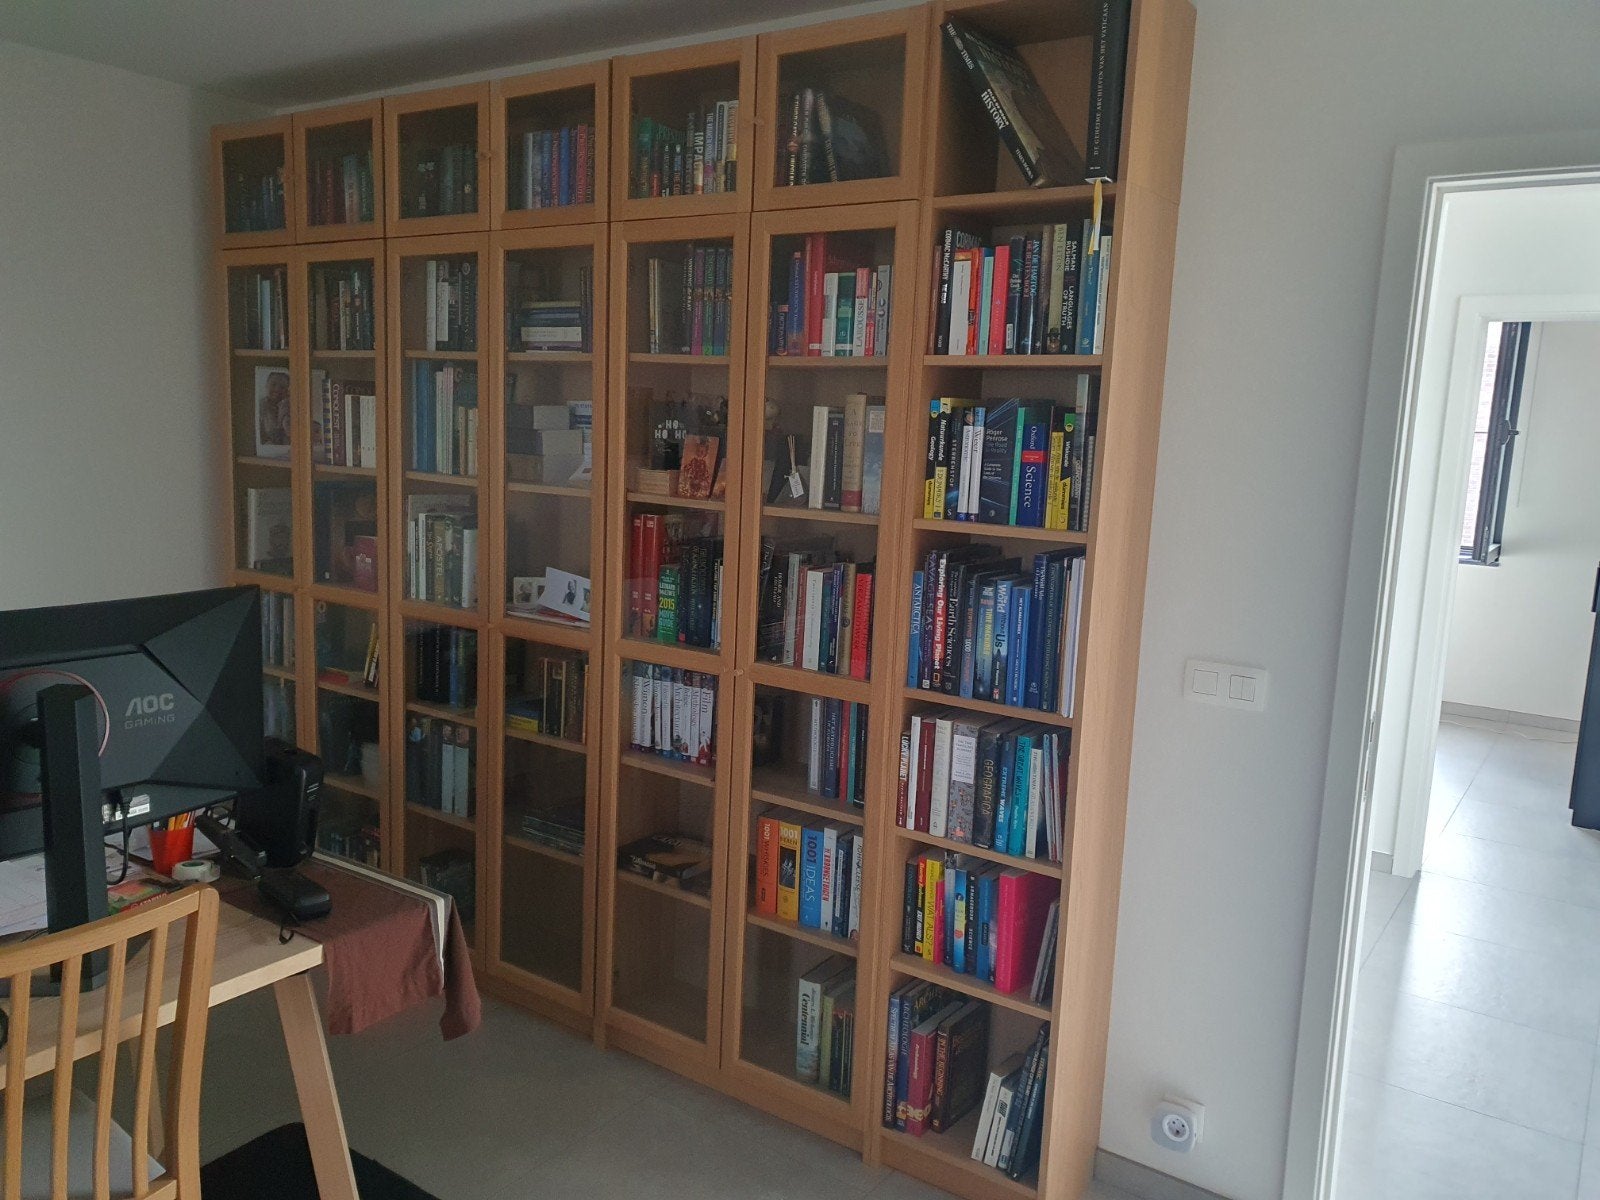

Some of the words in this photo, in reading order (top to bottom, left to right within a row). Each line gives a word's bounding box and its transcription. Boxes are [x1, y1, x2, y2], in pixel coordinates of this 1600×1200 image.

[946, 22, 957, 38] THE
[961, 49, 975, 70] TIMES
[981, 91, 1006, 130] HISTORY
[944, 230, 952, 252] CORMAC
[1032, 255, 1039, 264] DE
[1063, 290, 1068, 299] OF
[1066, 286, 1074, 330] LANGUAGES
[332, 384, 340, 430] CONQUEST
[654, 429, 668, 439] HO
[666, 420, 679, 429] HO
[1029, 426, 1038, 449] Oxford
[928, 436, 936, 460] Geology
[938, 419, 946, 461] Natuurkunde
[963, 428, 971, 462] Astronomie
[973, 430, 981, 454] Weer
[949, 439, 957, 487] STERRENSTOF
[1024, 465, 1036, 508] Science
[927, 553, 937, 601] SAVAGE
[937, 558, 946, 598] Exploring
[659, 597, 675, 609] 2015
[911, 583, 921, 634] ANTARCTICA
[948, 598, 958, 625] Earth
[996, 584, 1007, 613] World
[925, 603, 933, 631] SEAS
[934, 616, 943, 641] Living
[946, 627, 957, 667] Sciences
[995, 634, 1005, 648] Us
[934, 644, 942, 669] Planet
[125, 693, 174, 717] AOC
[701, 691, 711, 714] Film
[124, 714, 176, 730] GAMING
[901, 736, 909, 757] LUCKY
[899, 758, 909, 782] PLANET
[1000, 767, 1008, 797] EXTREME
[982, 759, 994, 815] GEOGRAFICA
[807, 835, 817, 864] 1001
[805, 865, 816, 902] IDEAS
[800, 993, 811, 1045] Centennial
[900, 1000, 910, 1056] ARCHEOLOGIE
[937, 1045, 946, 1059] THE
[936, 1060, 945, 1096] BEGINNING
